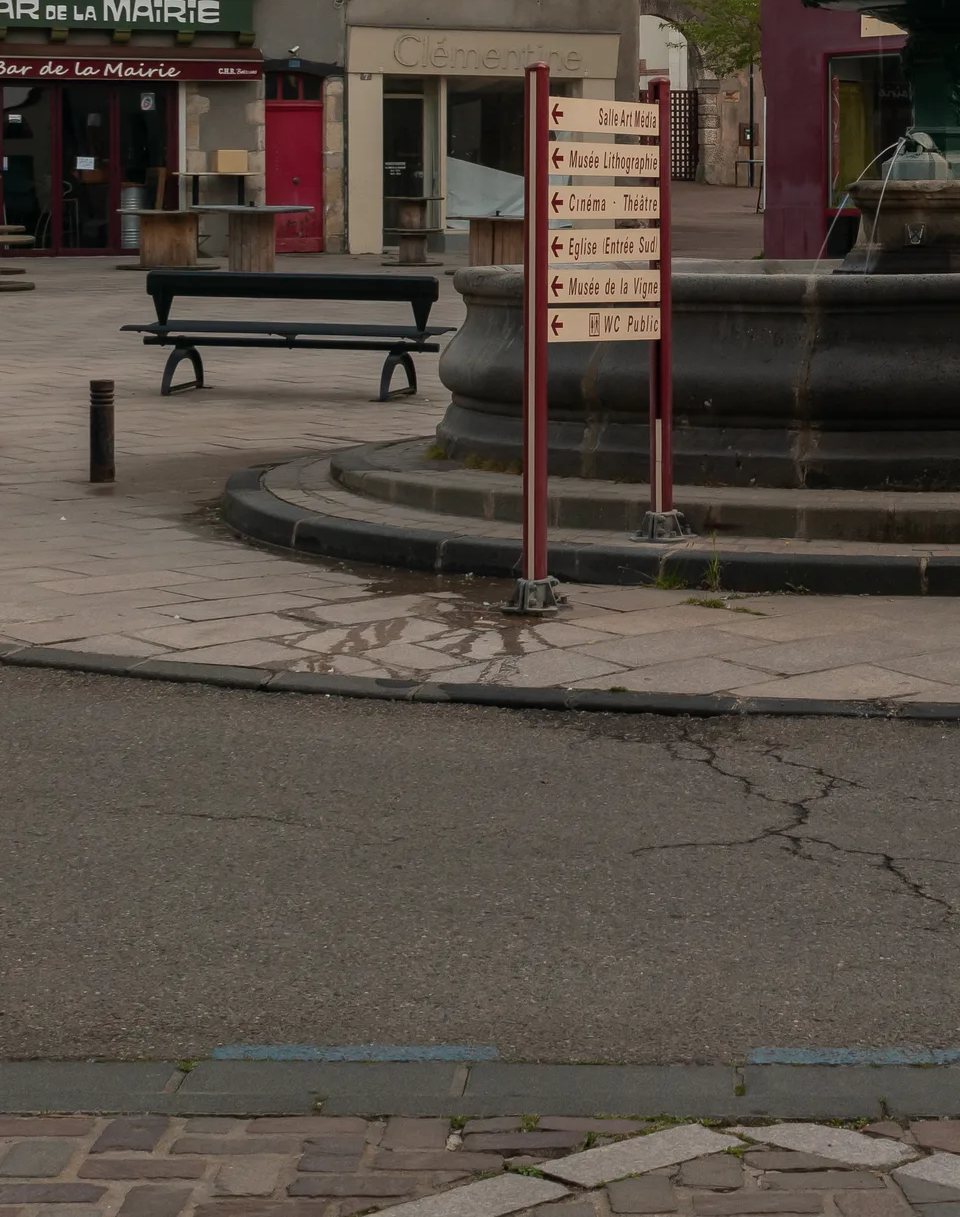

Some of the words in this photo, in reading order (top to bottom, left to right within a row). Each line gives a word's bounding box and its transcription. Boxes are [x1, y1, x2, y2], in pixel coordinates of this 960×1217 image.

[45, 4, 68, 21] DE
[73, 5, 97, 21] LA
[393, 34, 582, 71] Clémentine
[39, 60, 69, 76] de
[74, 61, 100, 76] la
[103, 62, 181, 78] Mairie
[598, 108, 619, 126] Salle
[620, 109, 633, 128] Art
[634, 110, 657, 129] Média
[569, 150, 600, 169] Musée
[603, 151, 658, 174] Lithographie
[568, 193, 606, 212] Cinéma
[623, 193, 658, 212] Théâtre
[568, 237, 597, 261] Eglise
[602, 236, 634, 255] (Entrée
[638, 235, 658, 254] Sud)
[568, 277, 600, 296] Musée
[604, 278, 616, 295] de
[620, 277, 628, 295] la
[633, 277, 658, 299] Vigne
[604, 315, 620, 333] WC
[627, 315, 659, 333] Public
